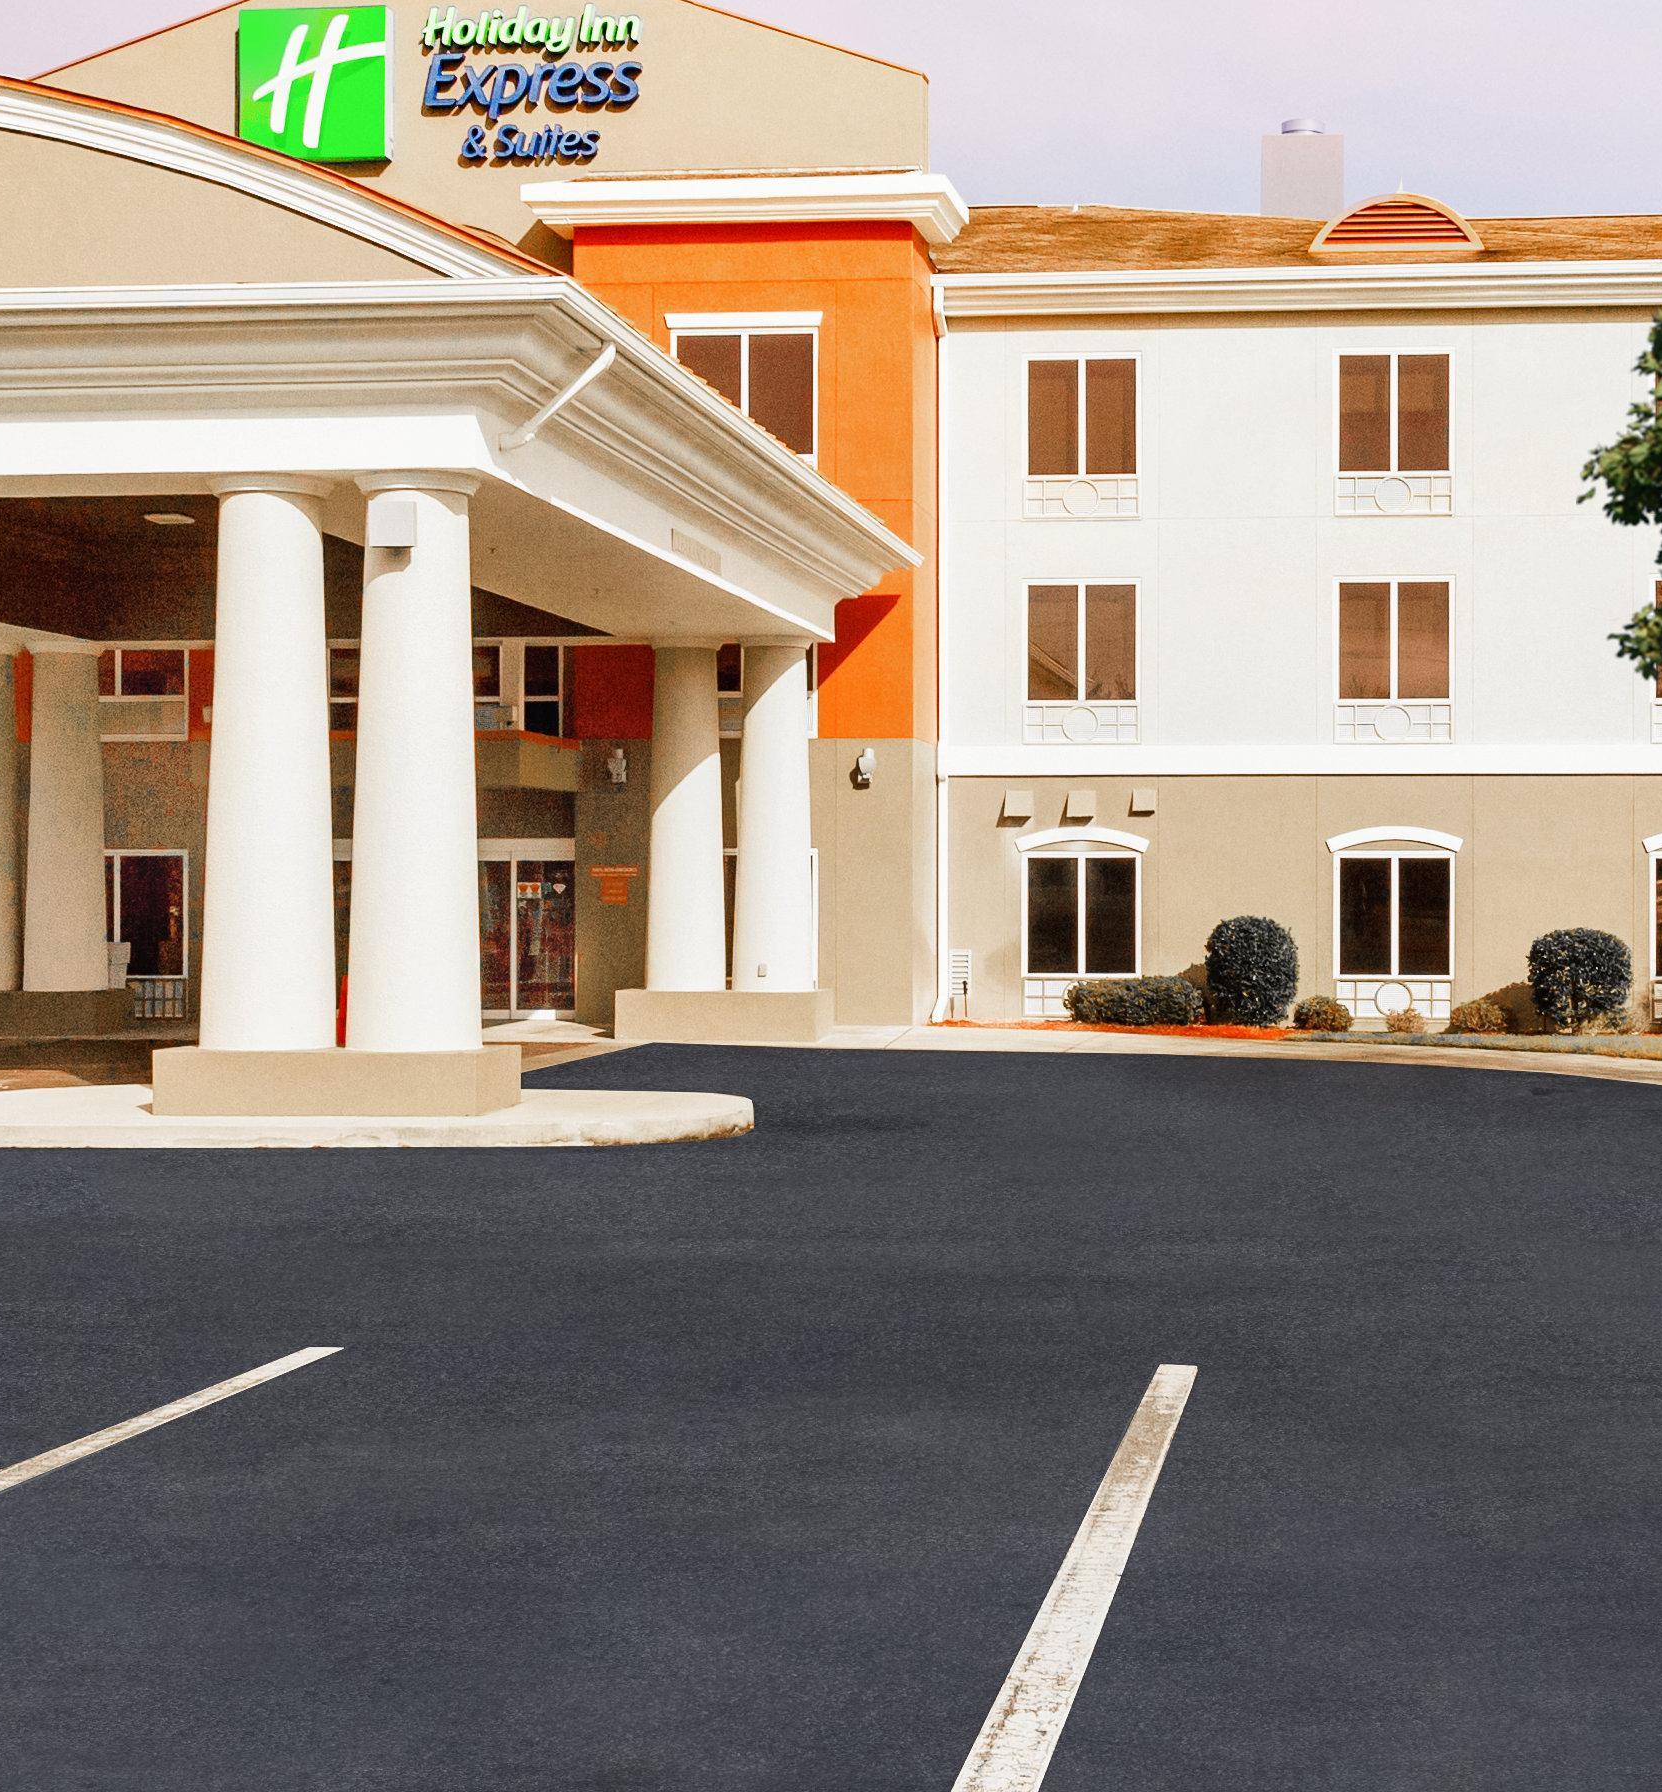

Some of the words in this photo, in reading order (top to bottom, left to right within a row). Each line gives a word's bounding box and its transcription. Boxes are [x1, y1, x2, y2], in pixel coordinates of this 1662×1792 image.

[420, 5, 577, 53] Holiday
[579, 3, 643, 44] Inn
[423, 53, 643, 120] Express
[461, 124, 487, 159] &
[494, 124, 600, 158] Suites
